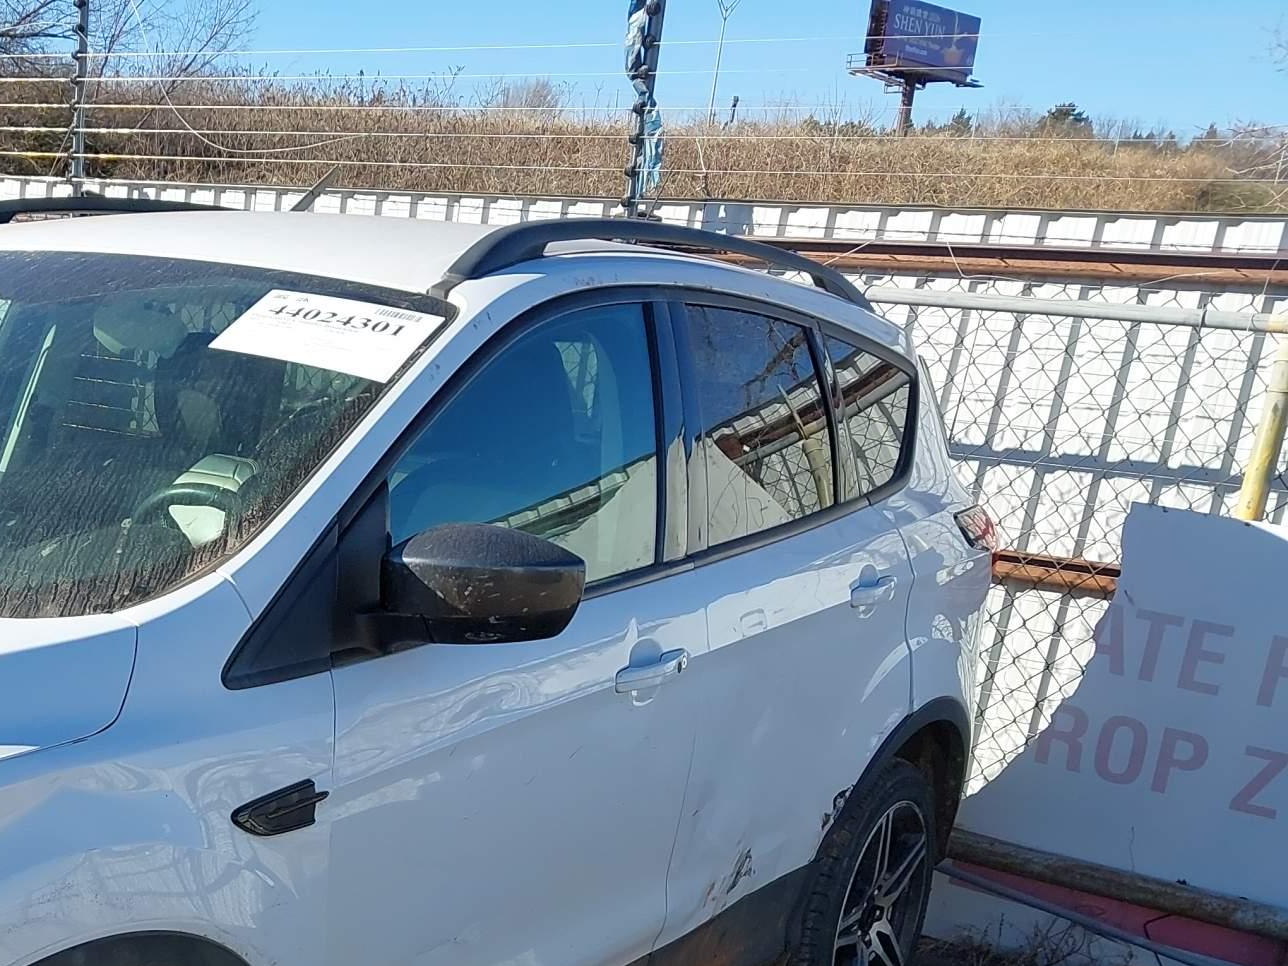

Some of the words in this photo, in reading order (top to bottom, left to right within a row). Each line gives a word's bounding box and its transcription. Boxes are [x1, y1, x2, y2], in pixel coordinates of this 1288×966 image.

[894, 13, 923, 34] SHEN
[925, 21, 947, 39] YUN
[268, 304, 406, 337] 44024301
